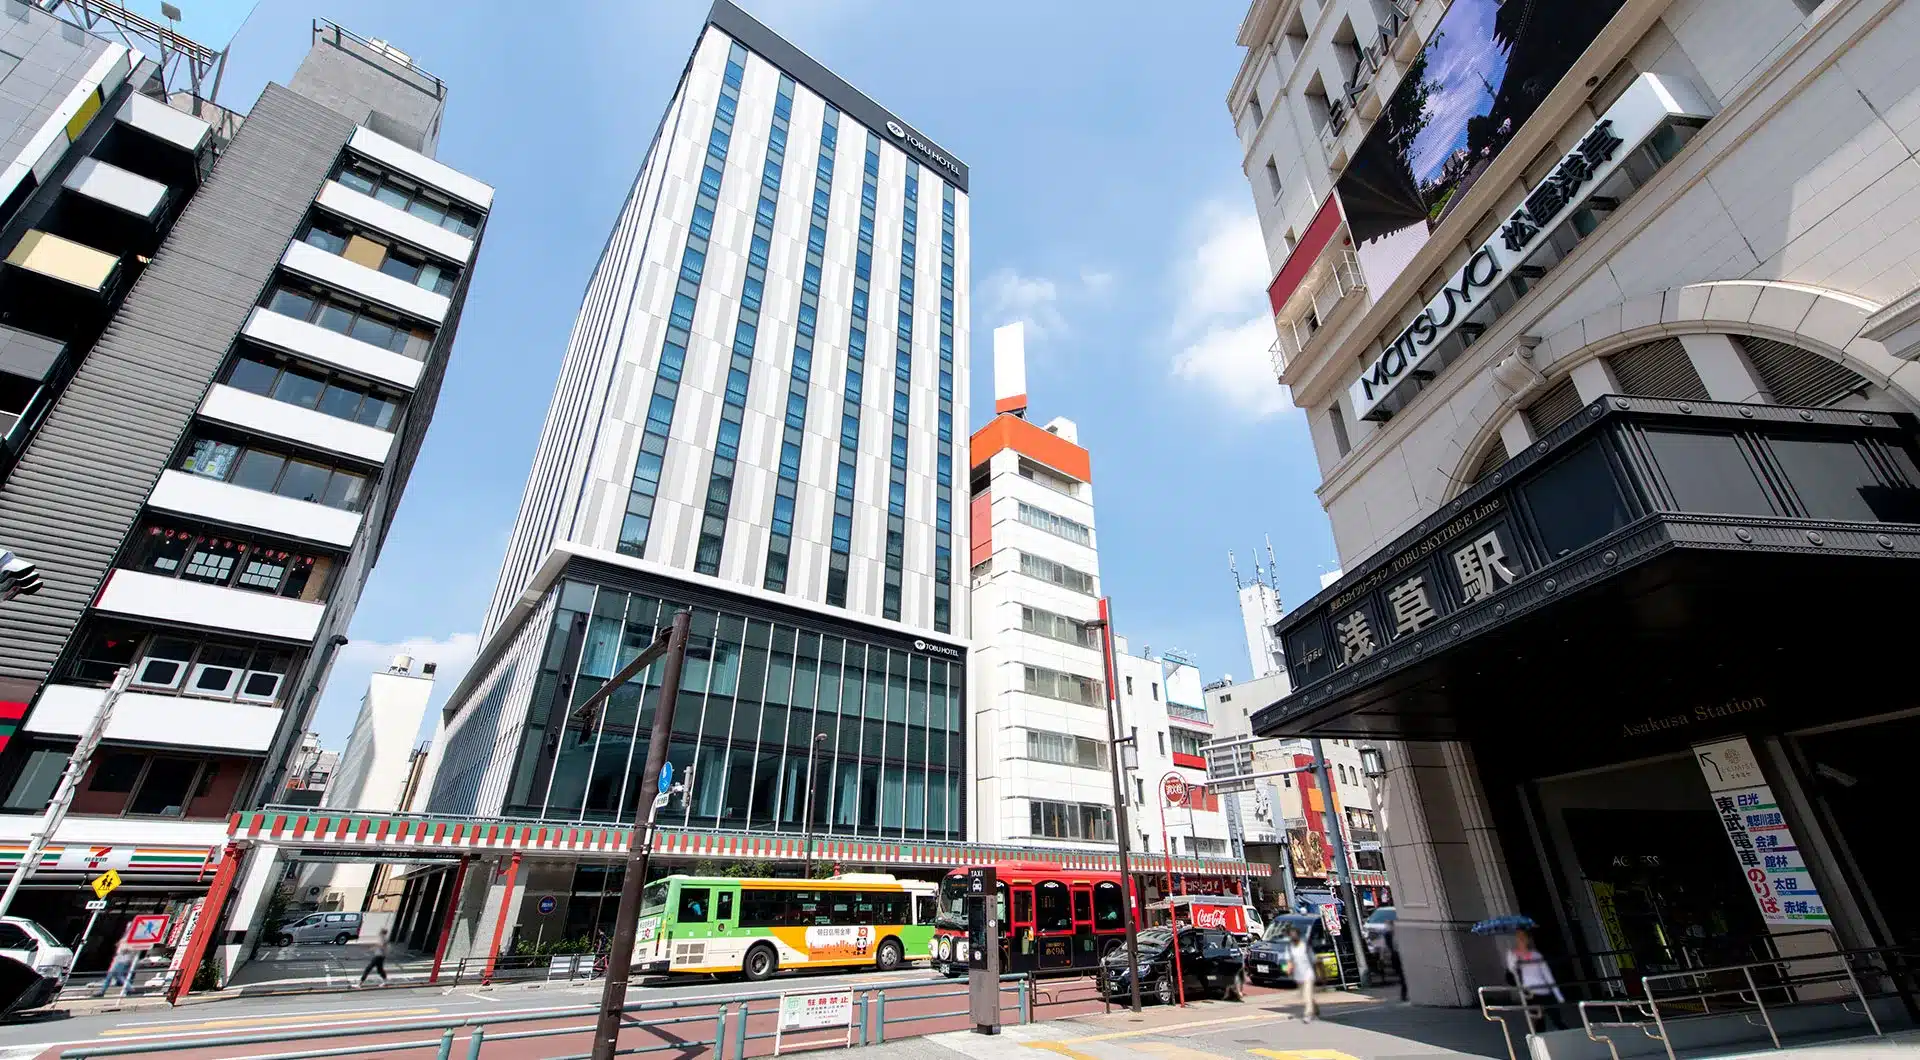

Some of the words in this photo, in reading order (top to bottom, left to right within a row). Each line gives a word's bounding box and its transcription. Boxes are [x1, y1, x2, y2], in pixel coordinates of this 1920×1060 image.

[1329, 0, 1424, 137] EKIM
[906, 133, 931, 155] TOBU
[932, 151, 960, 176] HOTEL
[1500, 119, 1624, 252] 松屋浅草
[1391, 549, 1420, 572] TOBU
[1421, 513, 1473, 553] SKYTREE
[1474, 498, 1500, 520] Line
[1336, 530, 1518, 669] 浅草駅
[925, 644, 941, 652] TOBU
[941, 647, 959, 657] HOTEL
[1303, 647, 1323, 667] TOBU
[1622, 711, 1690, 739] Asakusa
[1694, 694, 1767, 722] Station
[1737, 793, 1759, 806] 日光
[1746, 812, 1782, 827] 鬼怒川温泉
[1715, 796, 1780, 914] 東武電車のりば
[1755, 835, 1779, 849] 会津
[1764, 854, 1789, 868] 館林
[1773, 878, 1798, 890] 太田
